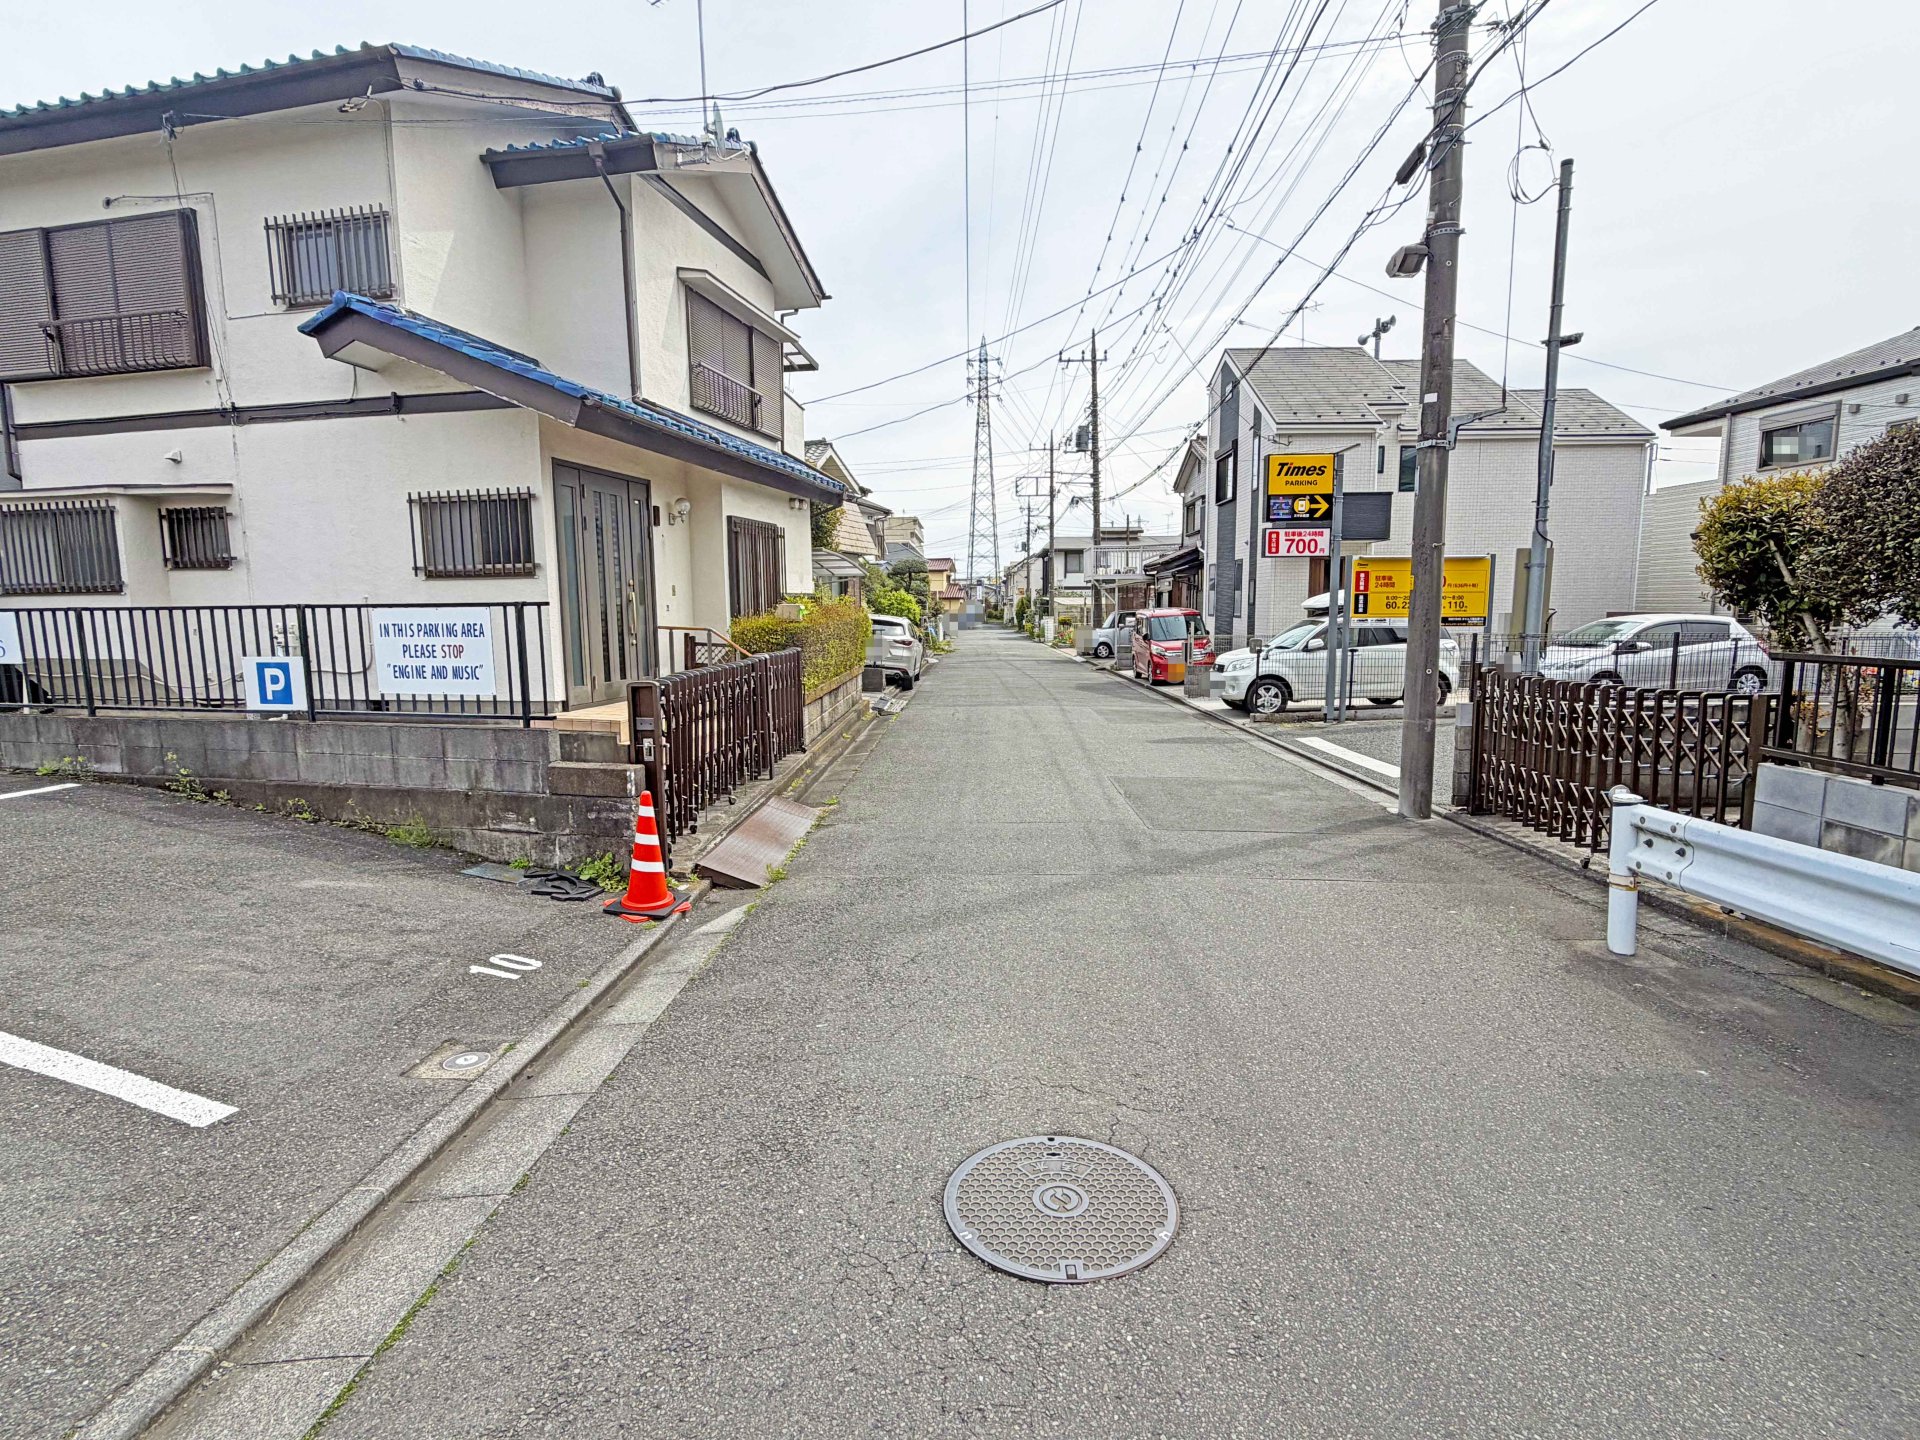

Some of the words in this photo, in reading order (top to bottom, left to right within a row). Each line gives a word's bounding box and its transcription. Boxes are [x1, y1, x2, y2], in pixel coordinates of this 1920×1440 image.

[1276, 462, 1327, 477] Times
[1284, 530, 1324, 538] 駐車後24時間
[379, 623, 390, 638] IN
[392, 623, 414, 638] THIS
[417, 623, 458, 638] PARKING
[461, 623, 485, 638] AREA
[402, 644, 437, 659] PLEASE
[441, 644, 465, 659] STOP
[431, 665, 448, 680] AND
[263, 667, 286, 701] P
[469, 953, 543, 980] 10
